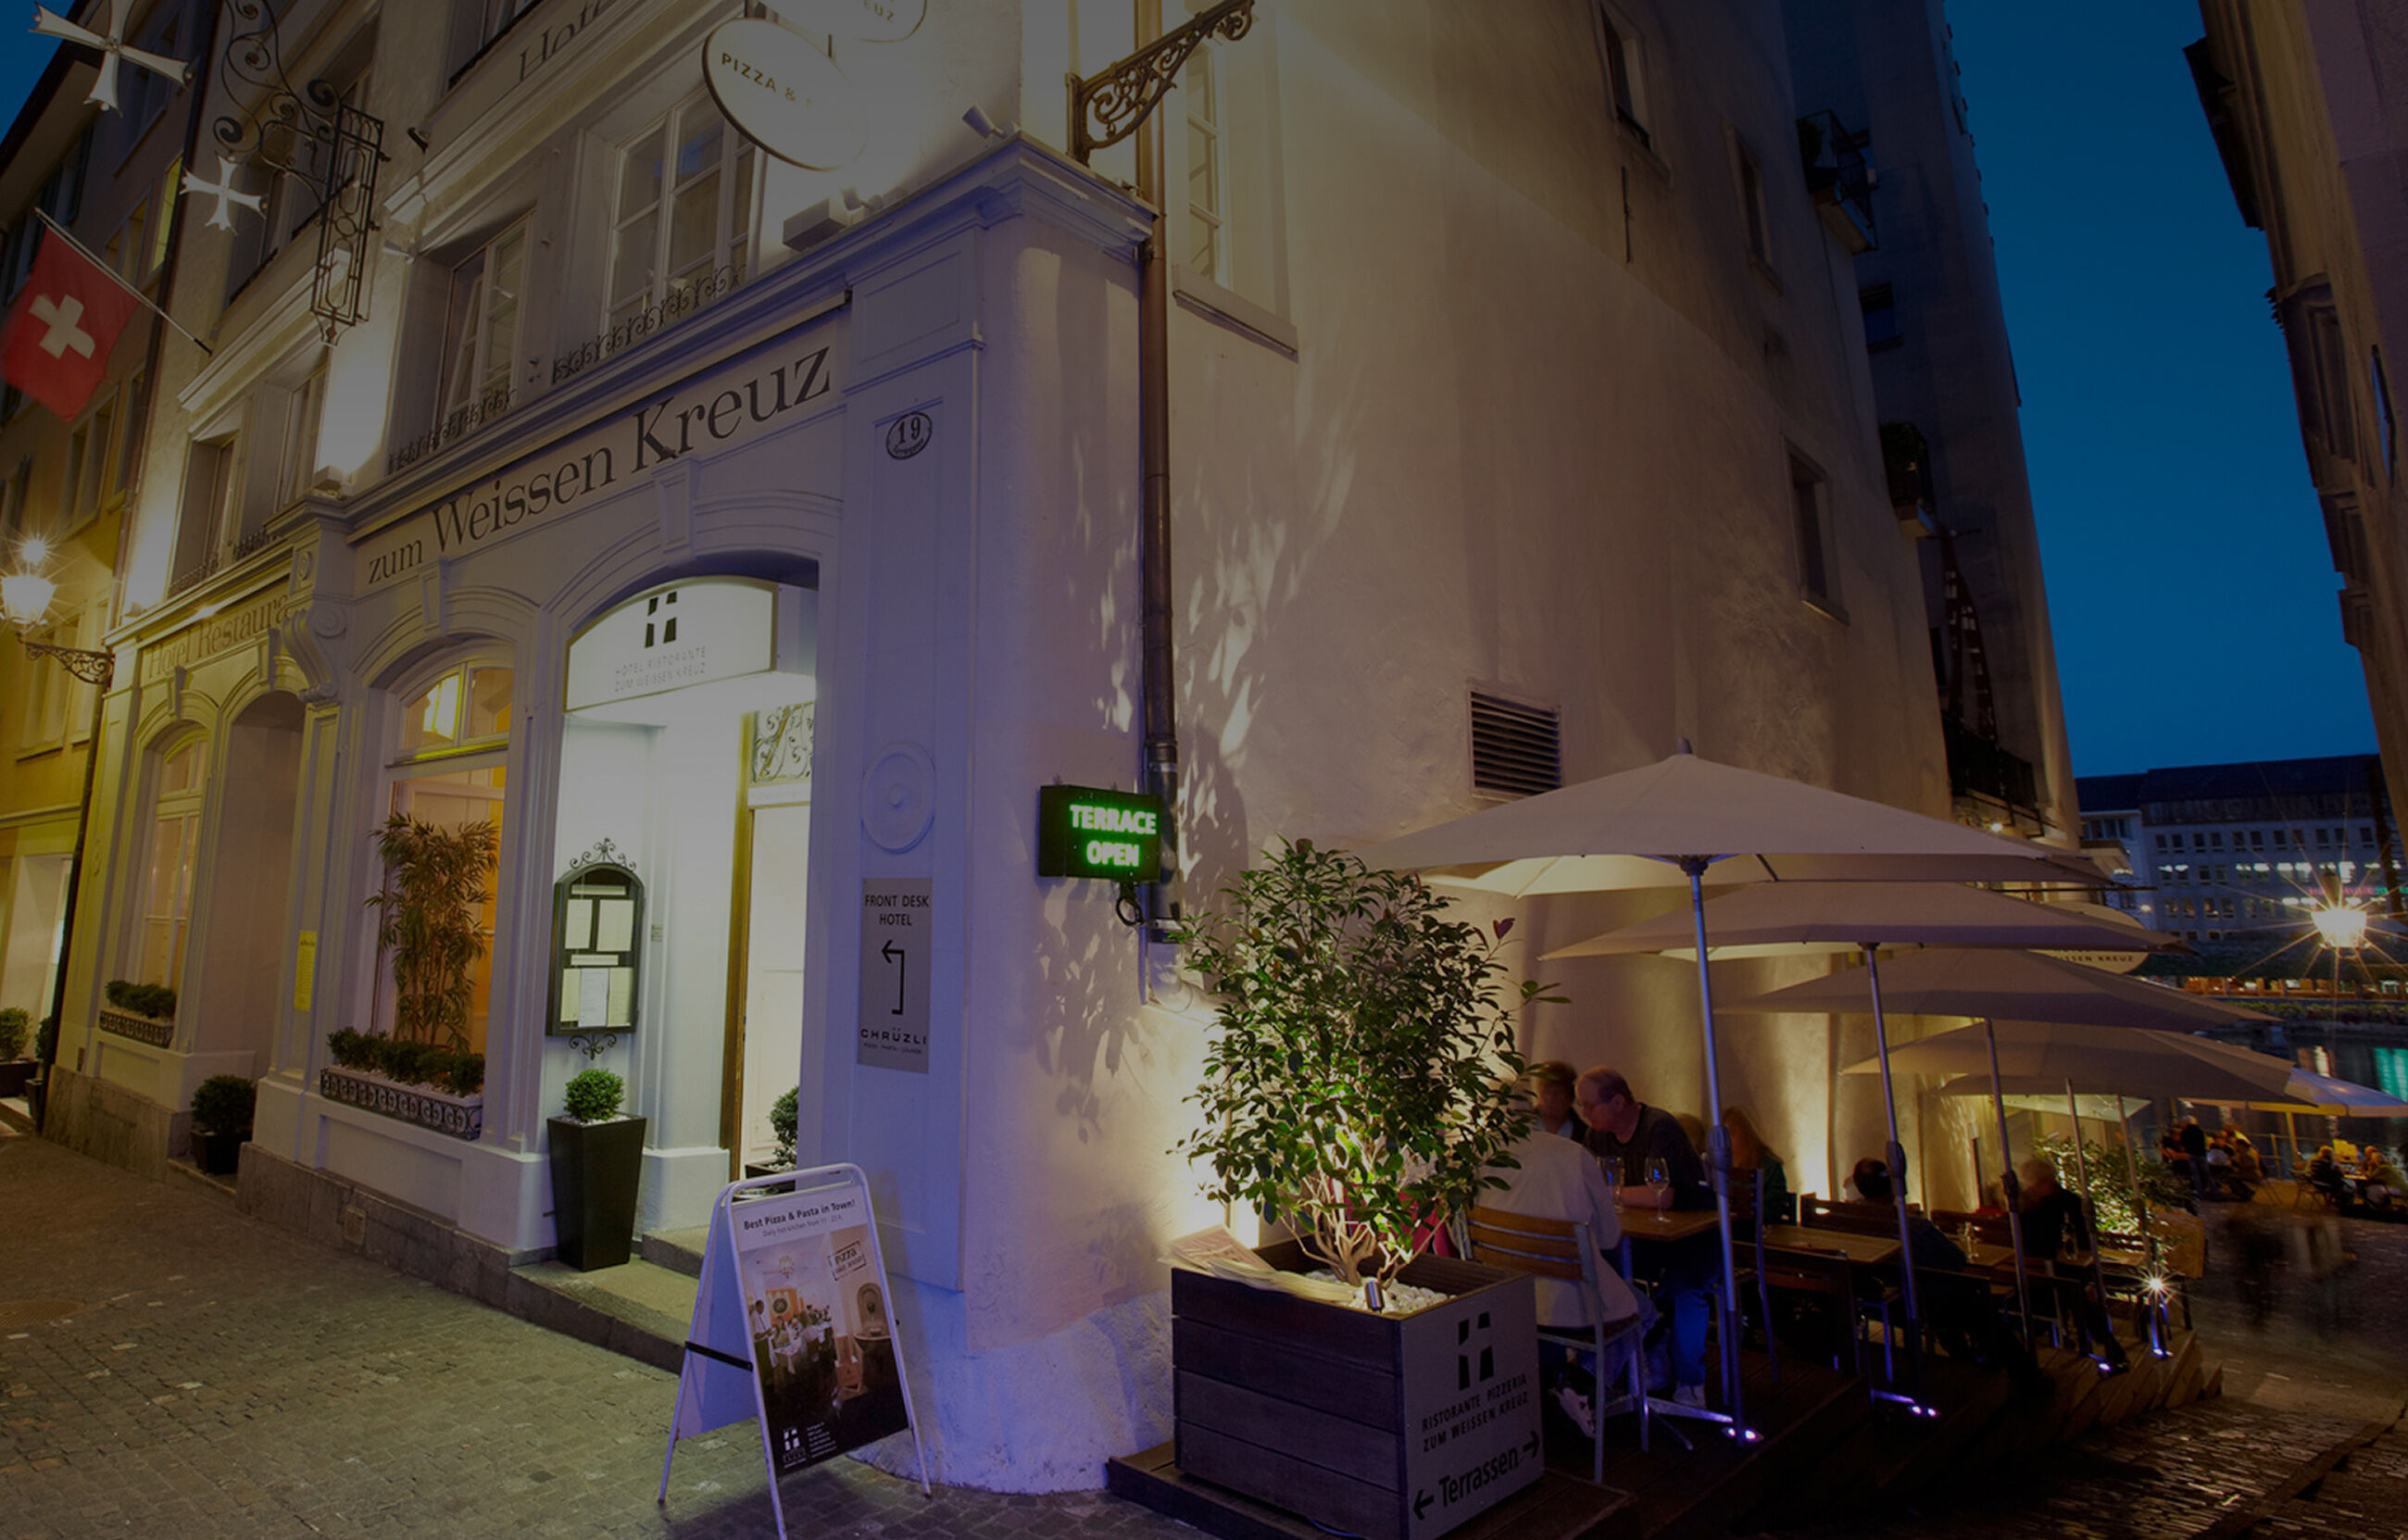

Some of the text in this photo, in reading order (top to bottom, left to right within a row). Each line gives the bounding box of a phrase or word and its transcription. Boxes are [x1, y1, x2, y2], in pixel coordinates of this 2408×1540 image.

[721, 52, 796, 103] PIZZA &
[898, 416, 921, 444] 19
[368, 345, 831, 585] zum Weissen Kreuz
[197, 594, 291, 658] Restaura
[1069, 804, 1158, 835] TERRACE
[1085, 839, 1141, 868] OPEN
[865, 894, 930, 908] FRONT DESK
[879, 913, 912, 927] HOTEL
[860, 1027, 927, 1045] CHRÜZLI
[744, 1218, 763, 1230] Best
[764, 1214, 786, 1225] Pizza
[787, 1211, 795, 1221] &
[796, 1208, 819, 1218] Pasta
[821, 1204, 830, 1214] in
[1422, 1372, 1528, 1433] RISTORANTE PIZZERIA
[1423, 1391, 1528, 1452] ZUM WEISSEN KREUZ
[1438, 1446, 1521, 1508] Terrassen
